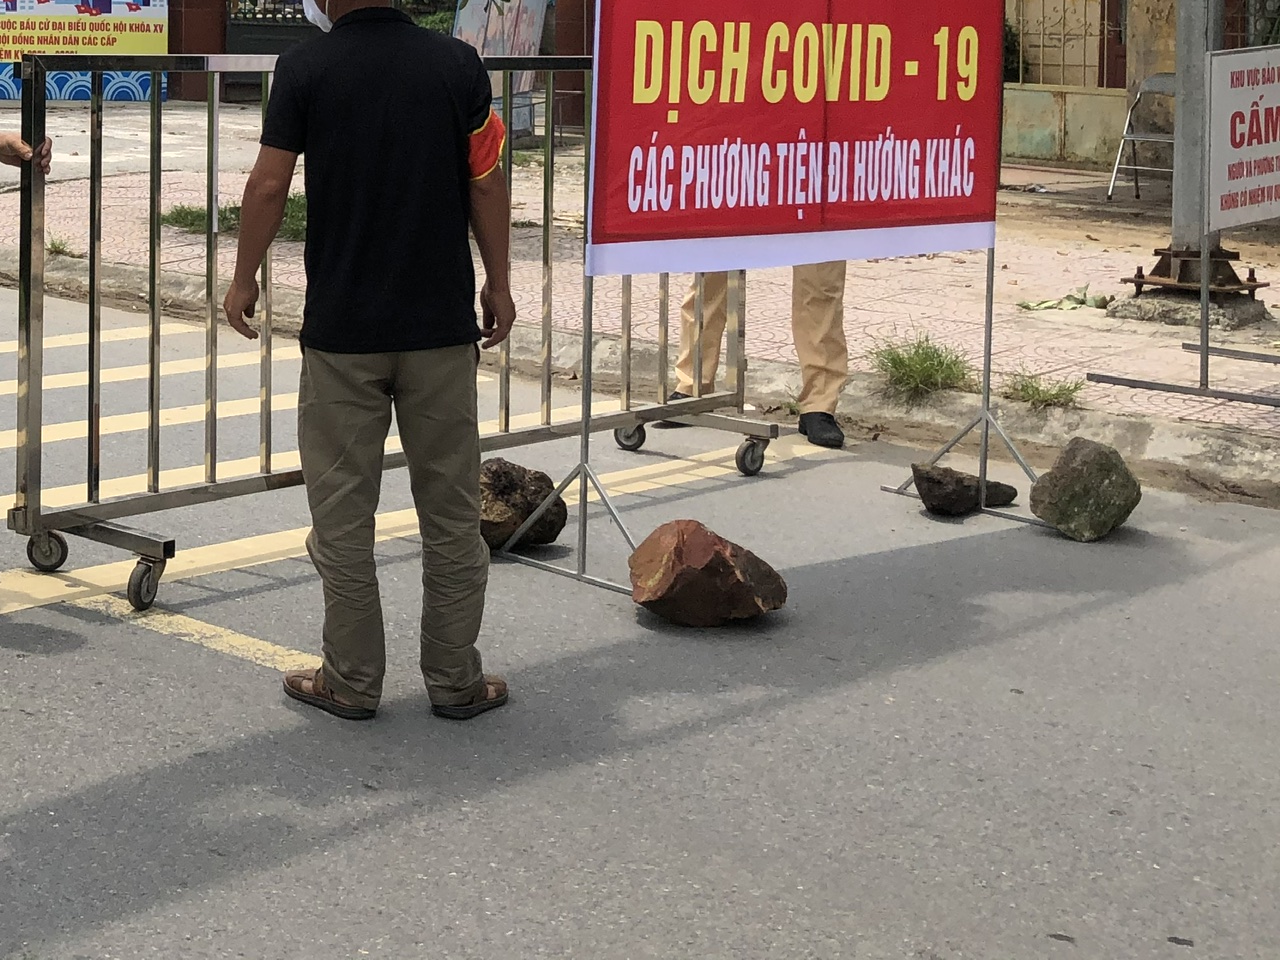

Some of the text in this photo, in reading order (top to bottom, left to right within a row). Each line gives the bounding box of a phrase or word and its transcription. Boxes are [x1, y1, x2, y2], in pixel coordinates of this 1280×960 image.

[36, 35, 60, 46] NHÂN
[62, 35, 80, 46] DÂN
[81, 35, 100, 46] CÁC
[100, 36, 117, 47] CẤP
[89, 20, 111, 33] QUỐC
[113, 21, 127, 34] HỘI
[129, 22, 151, 33] KHÓA
[154, 23, 164, 33] XV
[631, 19, 752, 124] DỊCH
[761, 21, 892, 104] COVID
[932, 25, 979, 102] 19
[1230, 70, 1245, 88] KHU
[1230, 94, 1280, 149] CẤM
[627, 124, 975, 220] CÁC PHƯƠNG TIỆN ĐI HƯỚNG KHÁC
